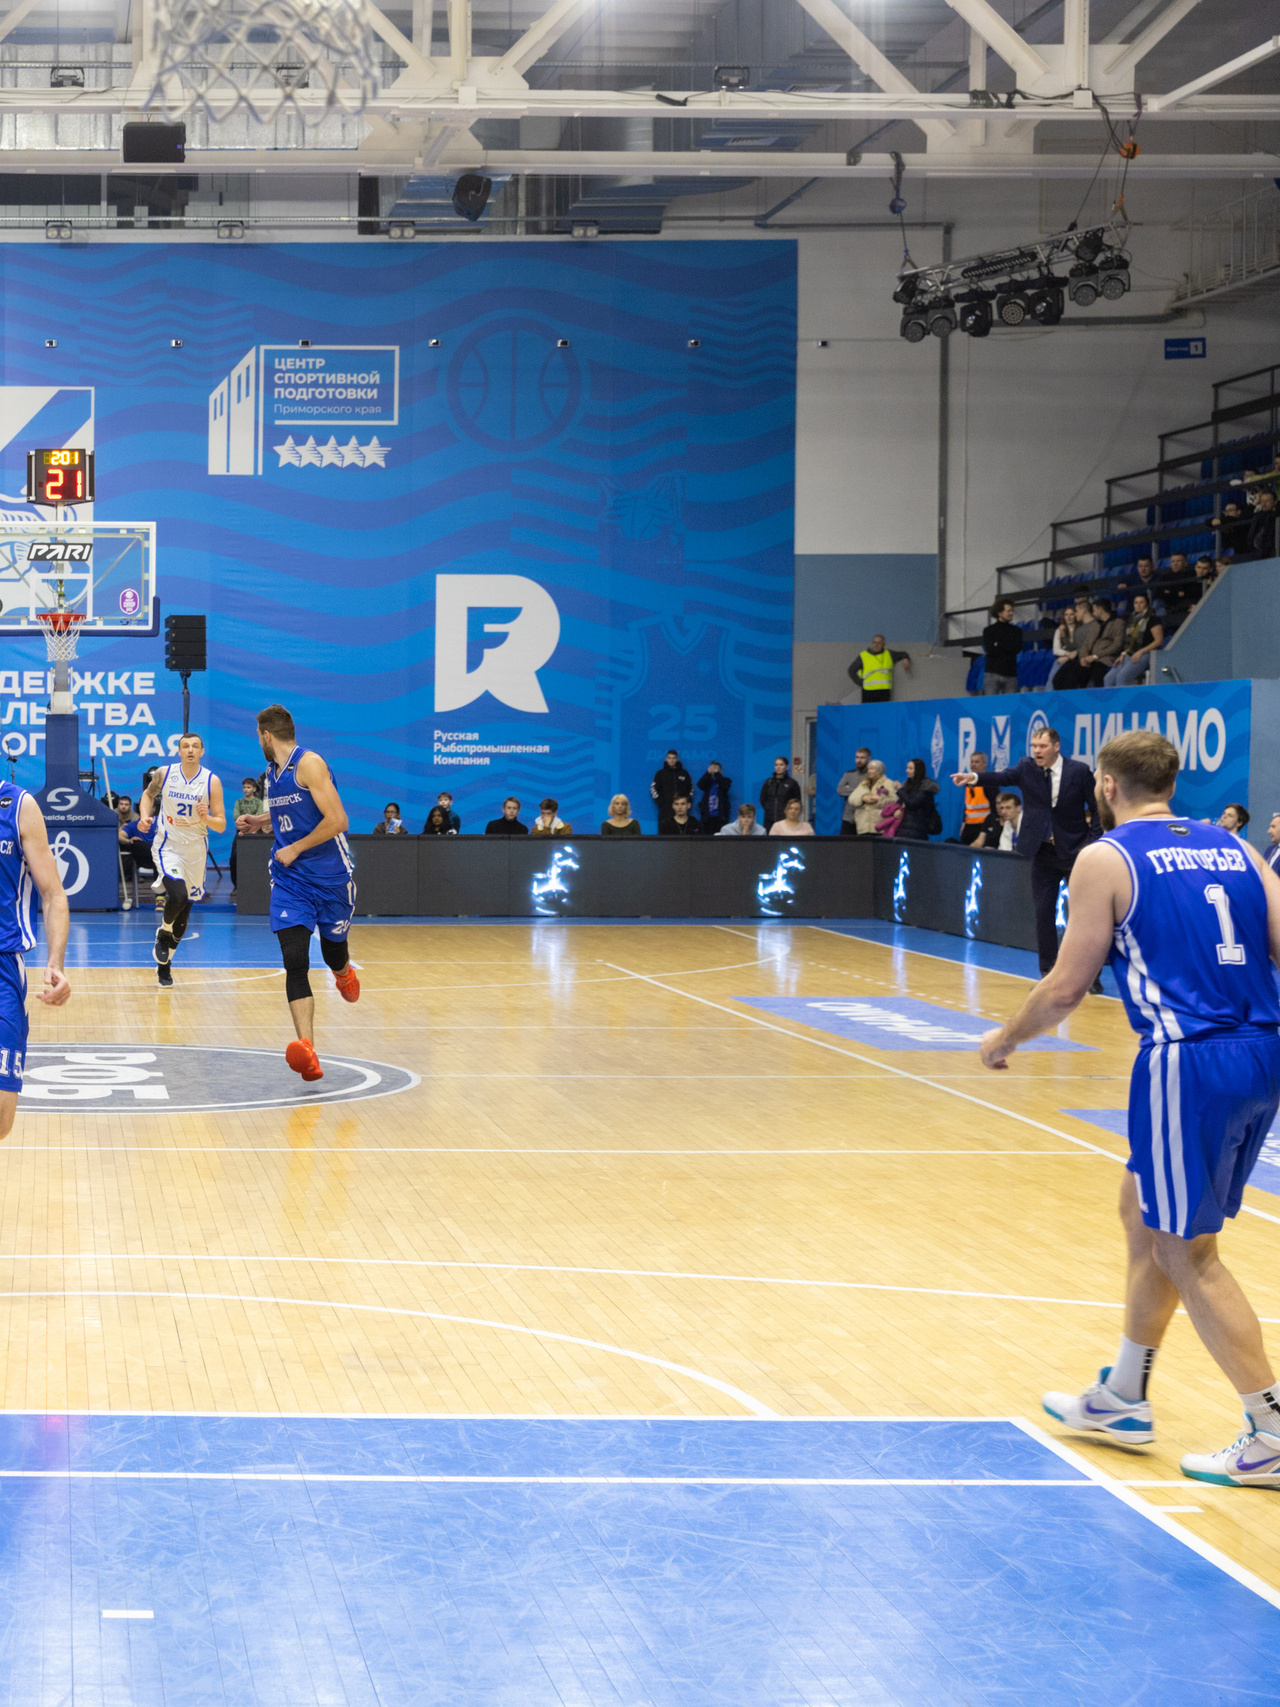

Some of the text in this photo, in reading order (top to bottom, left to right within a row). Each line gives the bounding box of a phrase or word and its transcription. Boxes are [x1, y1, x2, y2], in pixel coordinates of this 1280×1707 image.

[274, 358, 326, 371] ЦЕНТР
[273, 370, 380, 385] СПОРТИВНОЙ
[274, 388, 378, 401] ПОДГОТОВКИ
[274, 403, 382, 415] Приморского края
[46, 469, 82, 499] 21
[28, 544, 91, 560] PARI
[434, 730, 479, 742] Русская
[1071, 708, 1226, 772] ДИМО
[434, 742, 550, 755] Рыбопромышленная
[434, 755, 490, 765] Компания
[177, 803, 192, 816] 21
[67, 814, 95, 822] Sports
[278, 815, 294, 832] 20
[1146, 847, 1246, 875] ГРИГОРЬЕВ
[1204, 884, 1246, 965] 1
